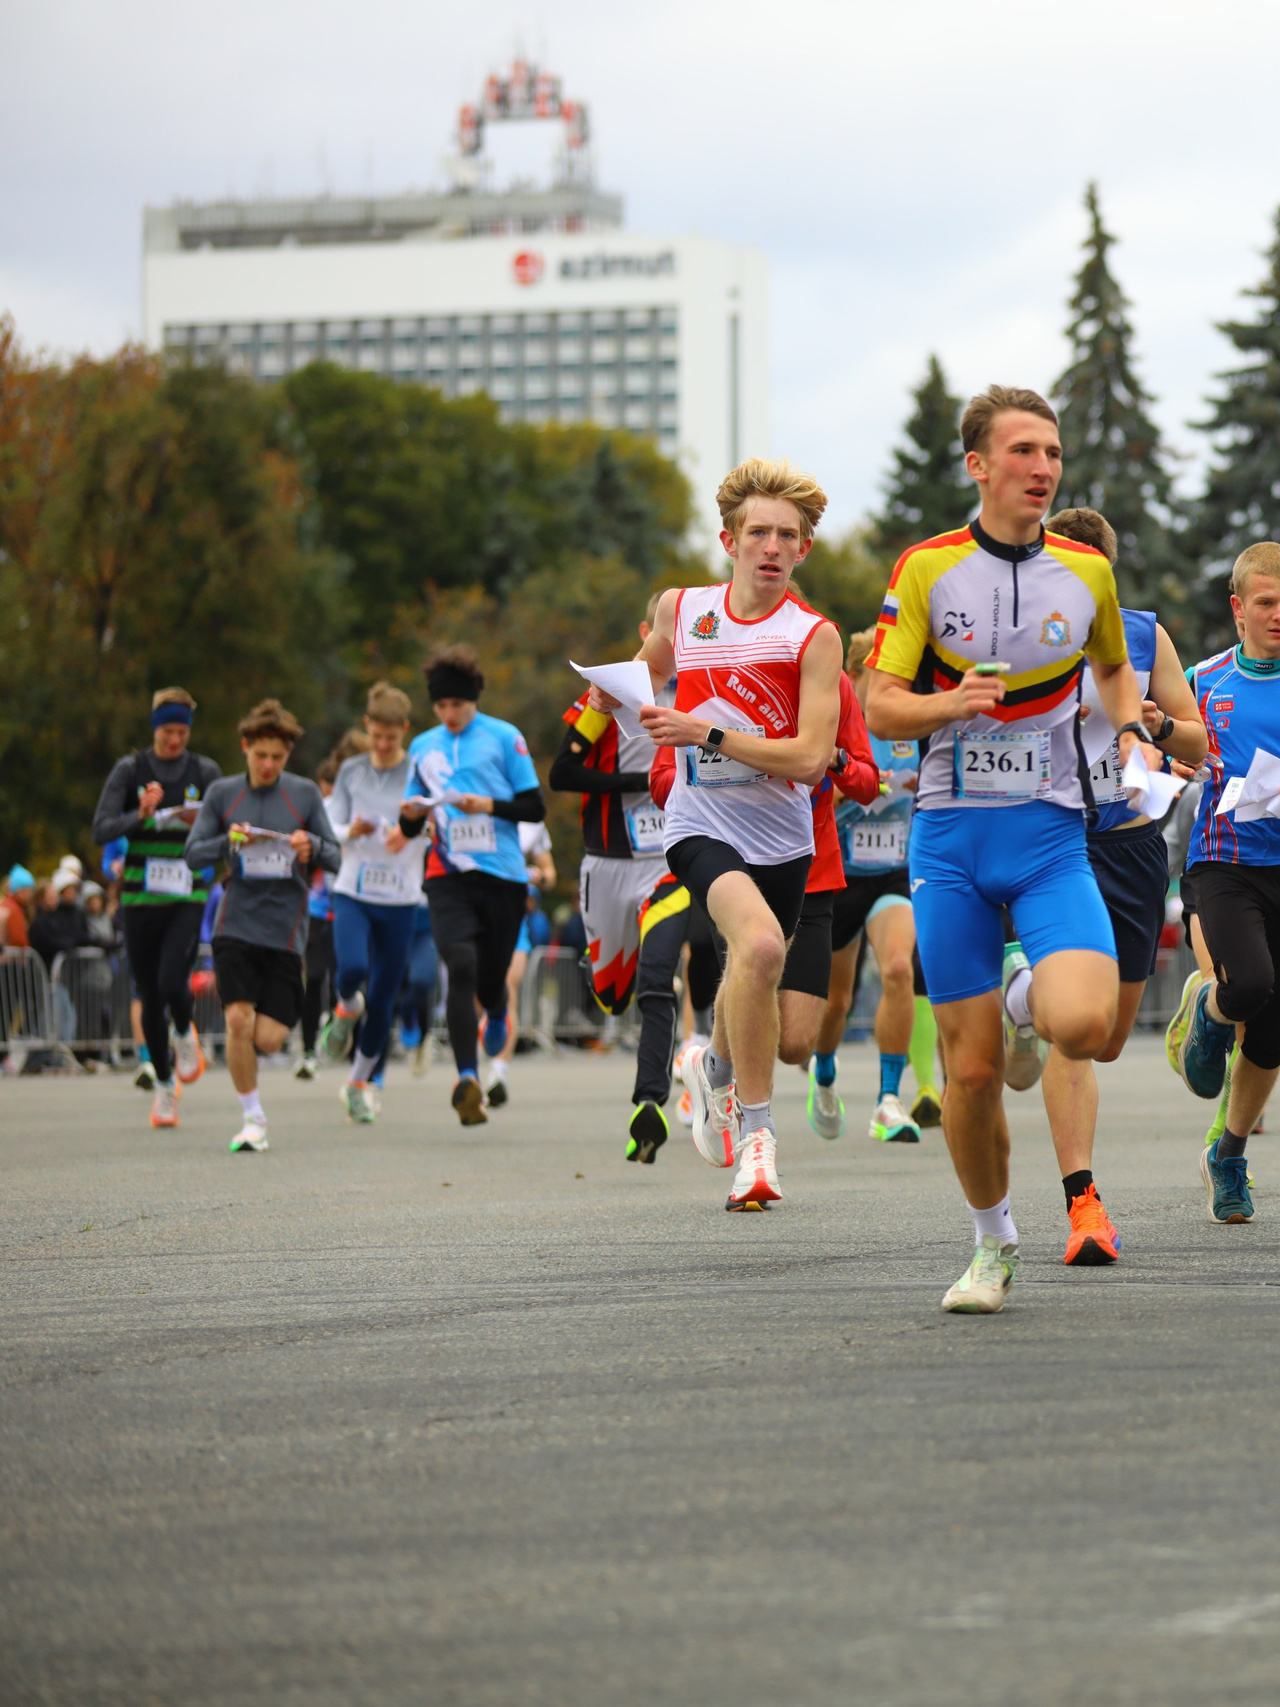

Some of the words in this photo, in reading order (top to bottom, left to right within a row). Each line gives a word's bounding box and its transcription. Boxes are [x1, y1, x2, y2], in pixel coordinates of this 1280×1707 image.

[558, 249, 676, 280] azimut
[726, 674, 757, 704] Run
[758, 702, 788, 732] and
[965, 750, 1034, 773] 236.1
[855, 832, 895, 848] 211.1
